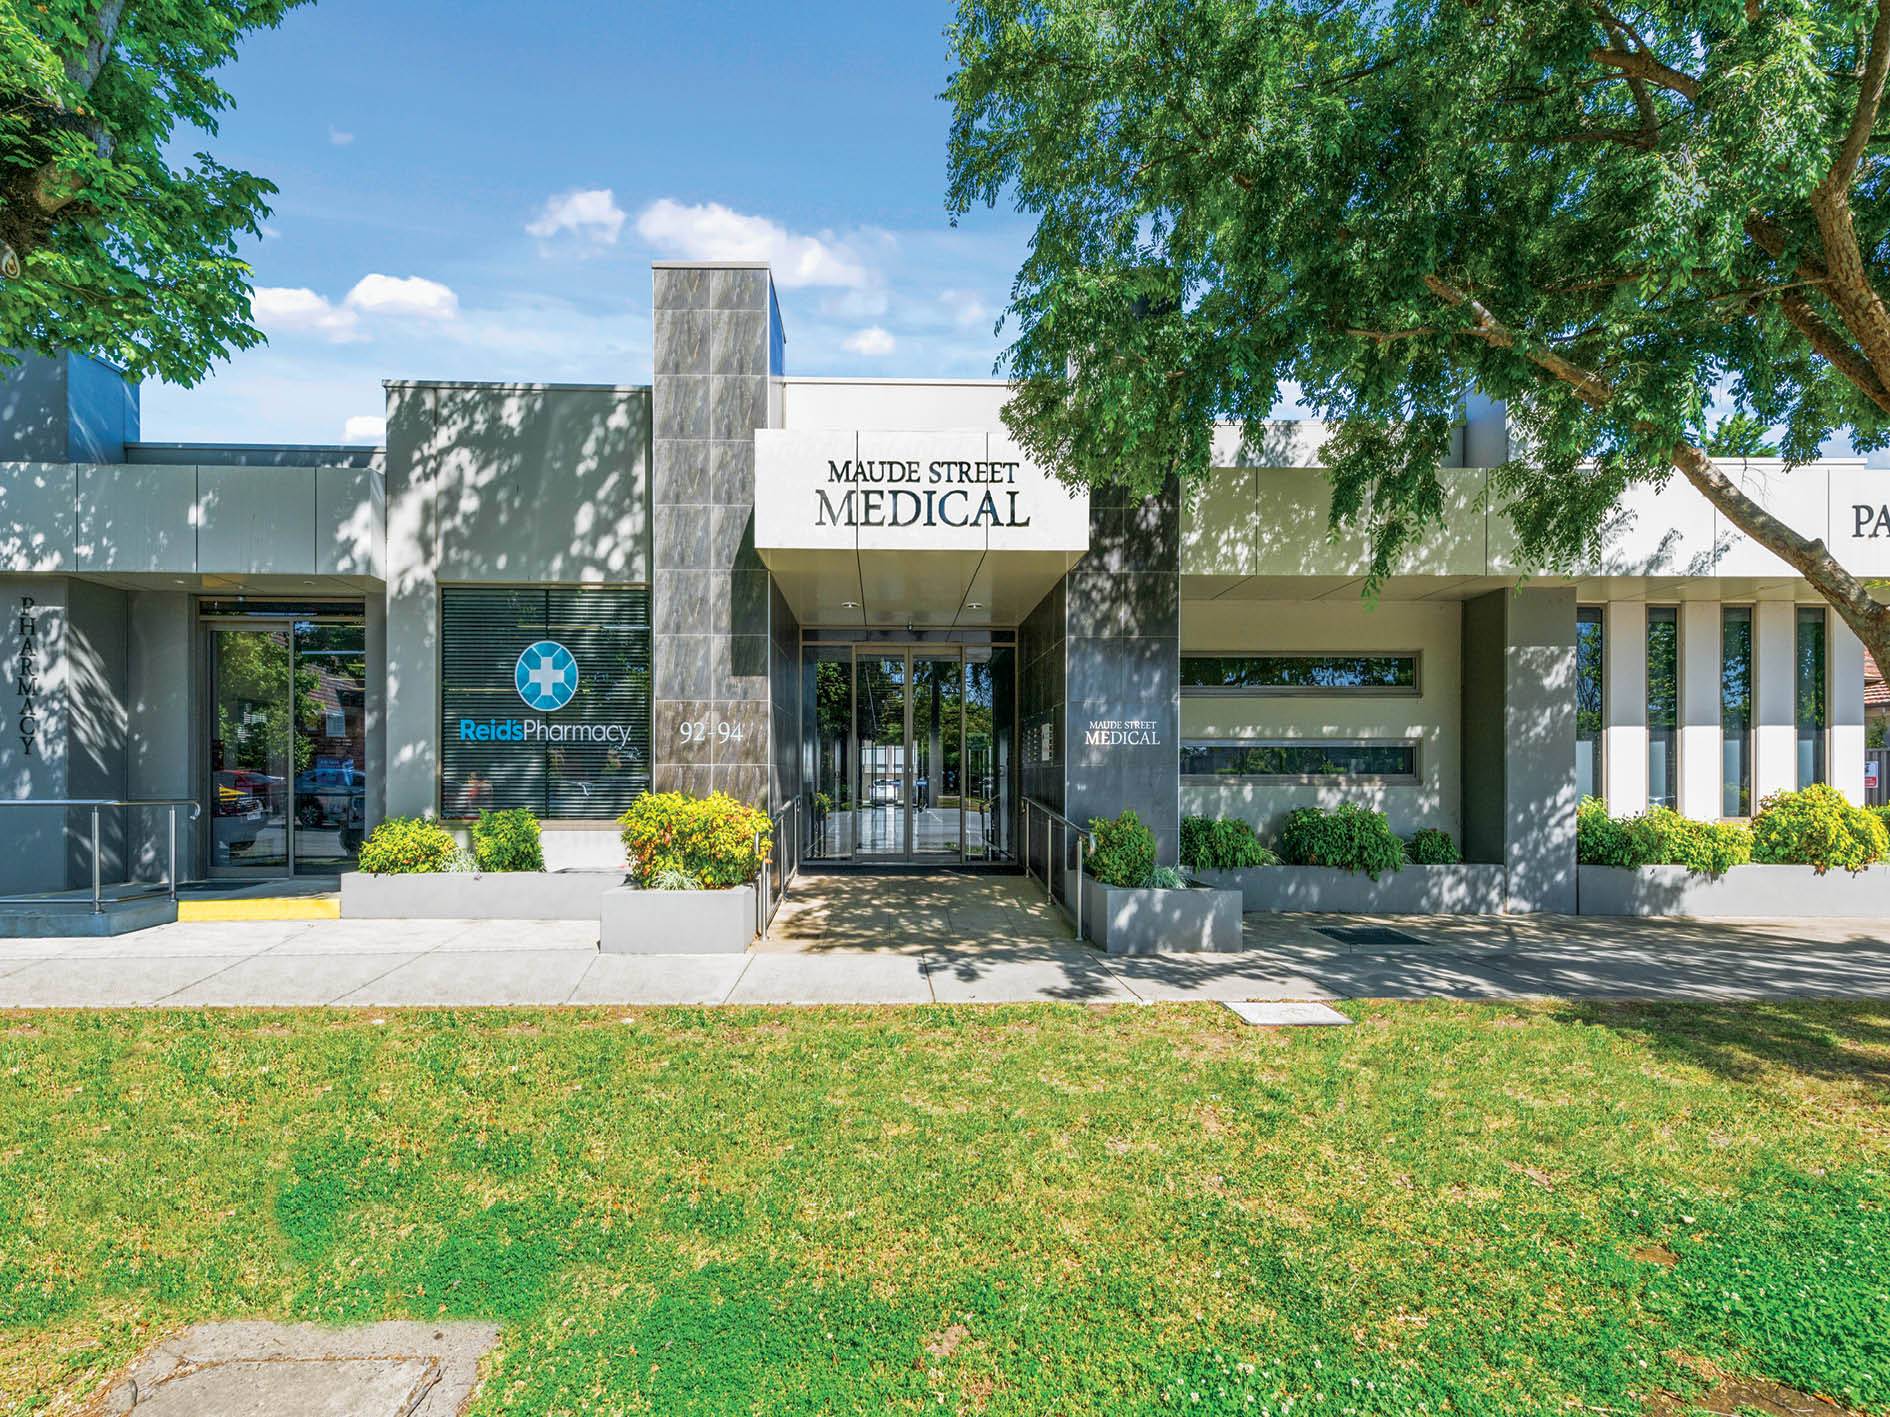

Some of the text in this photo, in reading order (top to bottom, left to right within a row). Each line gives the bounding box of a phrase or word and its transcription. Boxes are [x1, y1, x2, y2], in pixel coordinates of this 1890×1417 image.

[828, 460, 1019, 484] MAUDE STREET
[815, 489, 1031, 527] MEDICAL
[17, 596, 38, 755] PHARMACY
[1089, 720, 1157, 730] MAUDE STREET
[1085, 731, 1160, 745] MEDICAL
